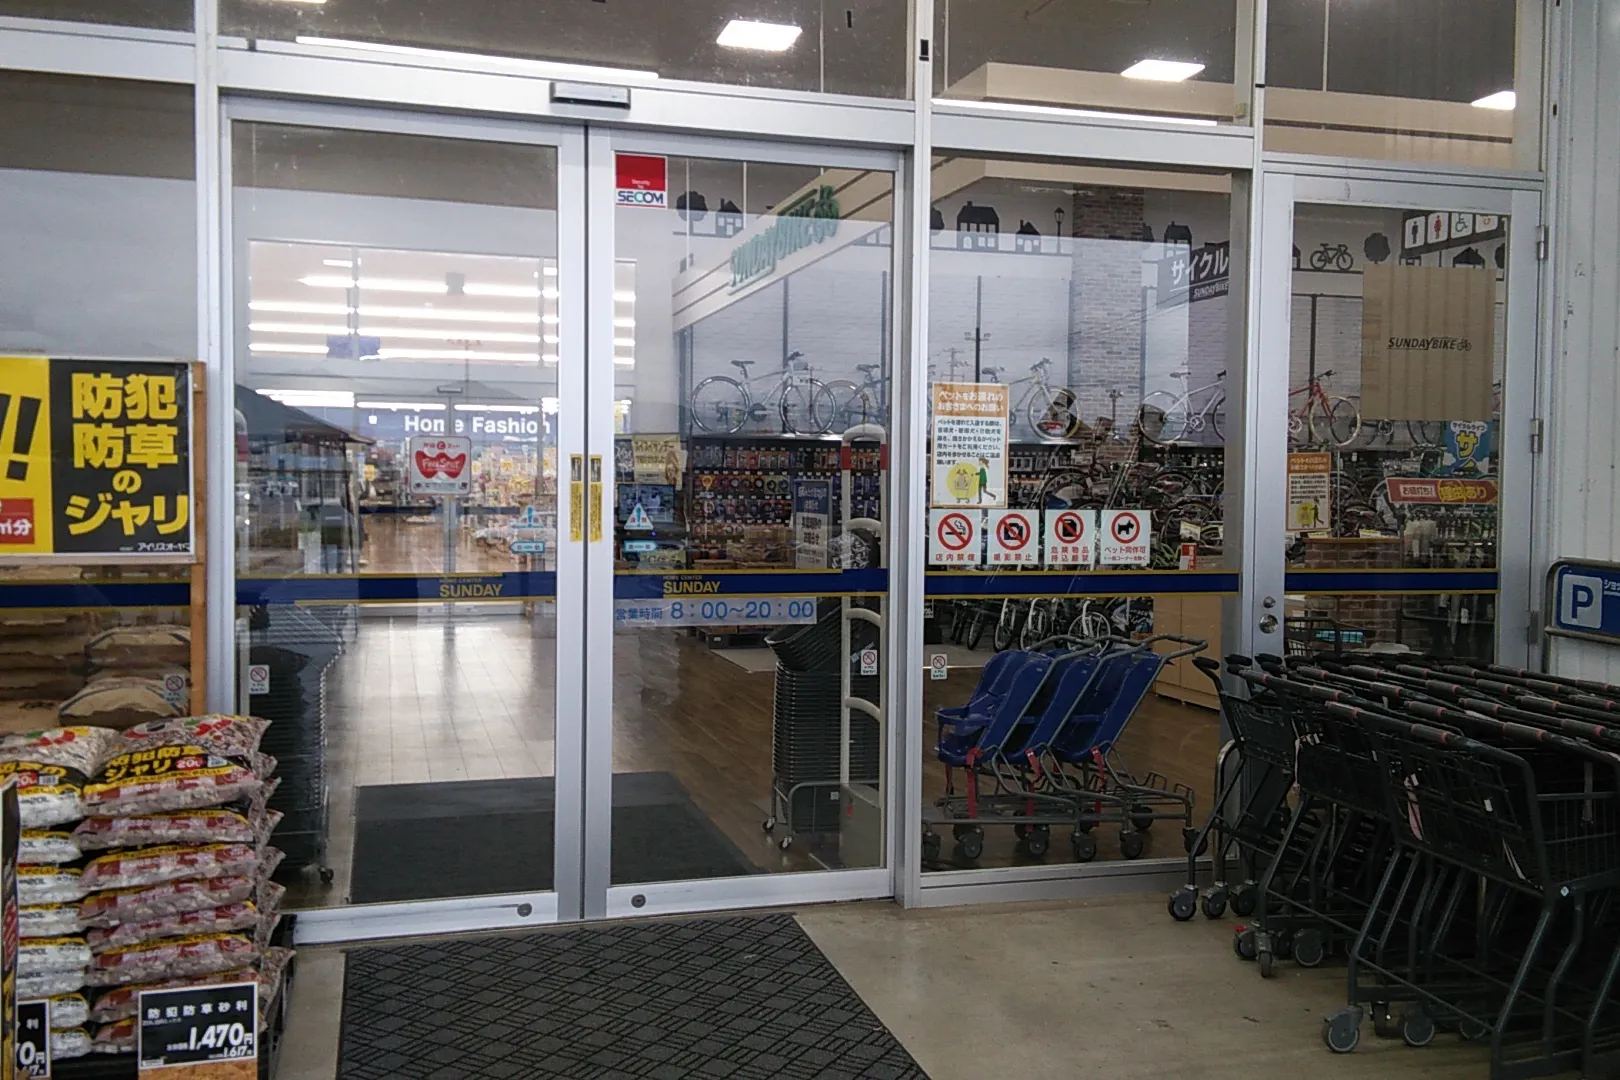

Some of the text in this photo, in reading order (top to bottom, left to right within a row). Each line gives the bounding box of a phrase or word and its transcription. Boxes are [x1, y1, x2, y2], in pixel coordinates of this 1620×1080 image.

[618, 190, 664, 204] SECOM
[1171, 247, 1229, 286] サイクル
[1387, 336, 1458, 351] SUNDAYBIKE
[72, 373, 178, 420] 防犯
[73, 423, 179, 469] 防草
[112, 469, 142, 494] の
[65, 493, 189, 536] ジャリ
[440, 583, 503, 597] SUNDAY
[663, 580, 720, 594] SUNDAY
[1571, 583, 1594, 619] P
[615, 608, 663, 621] 営業時間
[104, 757, 172, 783] ジャリ
